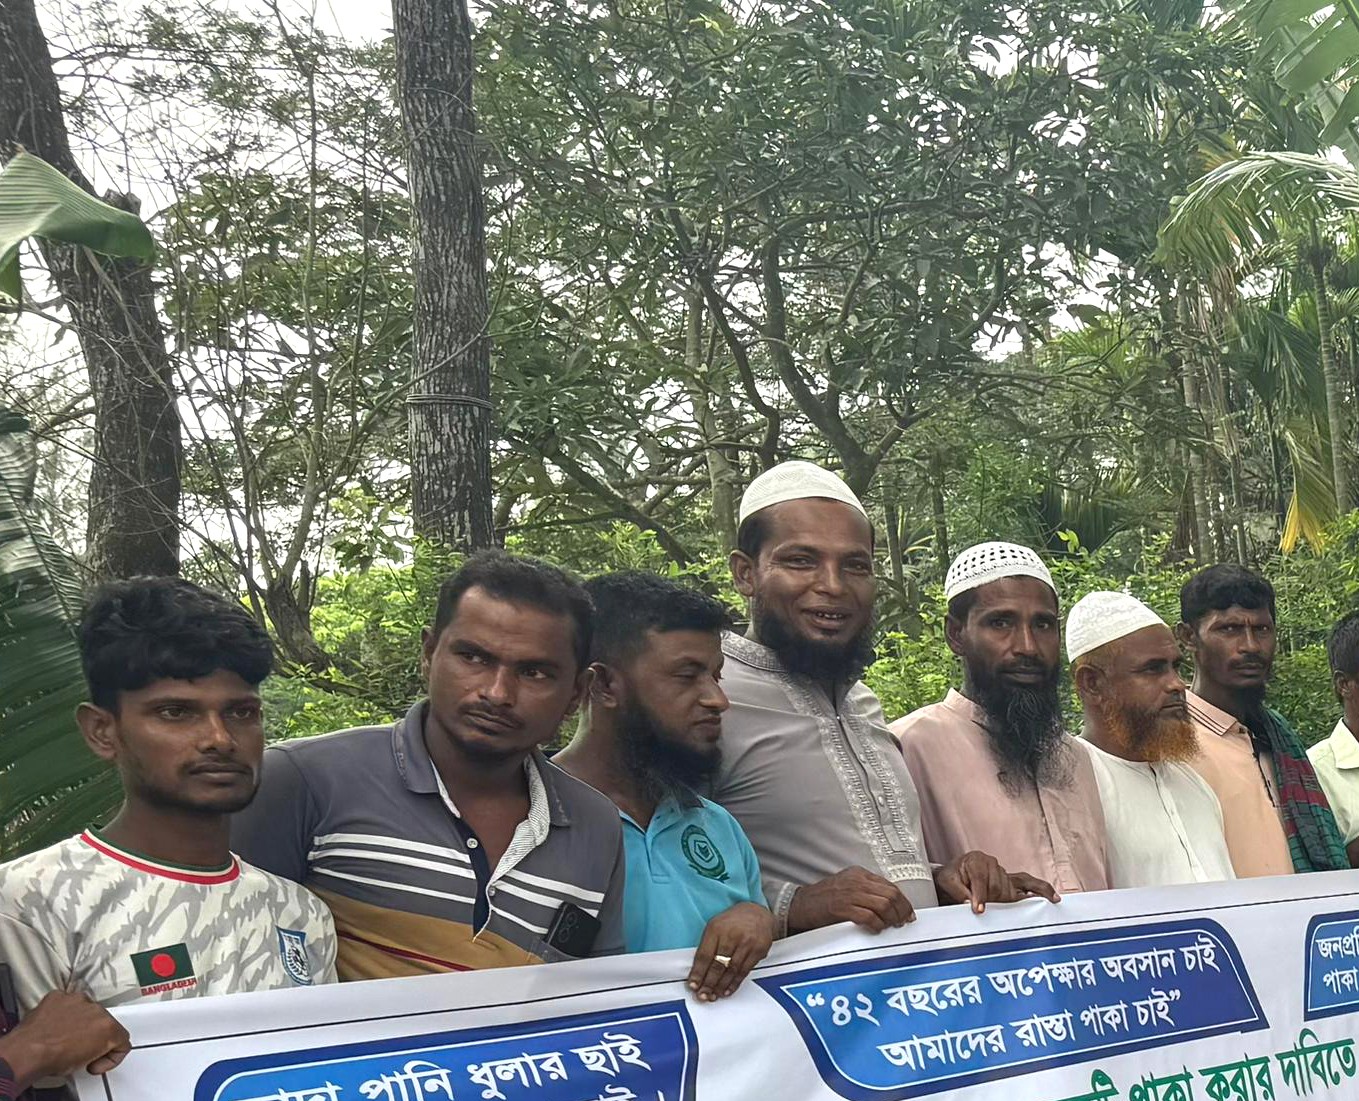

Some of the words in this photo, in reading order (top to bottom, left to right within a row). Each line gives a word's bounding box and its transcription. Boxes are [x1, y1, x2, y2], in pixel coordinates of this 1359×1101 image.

[881, 976, 983, 1018] বছরের
[986, 957, 1096, 999] অপেক্ষার
[1100, 946, 1178, 982] অবসান
[1182, 934, 1222, 974] চাই
[1322, 966, 1359, 995] পাকা
[876, 1025, 1007, 1071] আমাদের
[1009, 1011, 1076, 1049] রাস্তা
[1080, 998, 1129, 1034] পাকা
[1134, 987, 1182, 1027] চাই”
[1275, 1028, 1358, 1096] দাবিতে
[467, 1052, 568, 1101] ধুলার
[569, 1031, 652, 1078] ছাই
